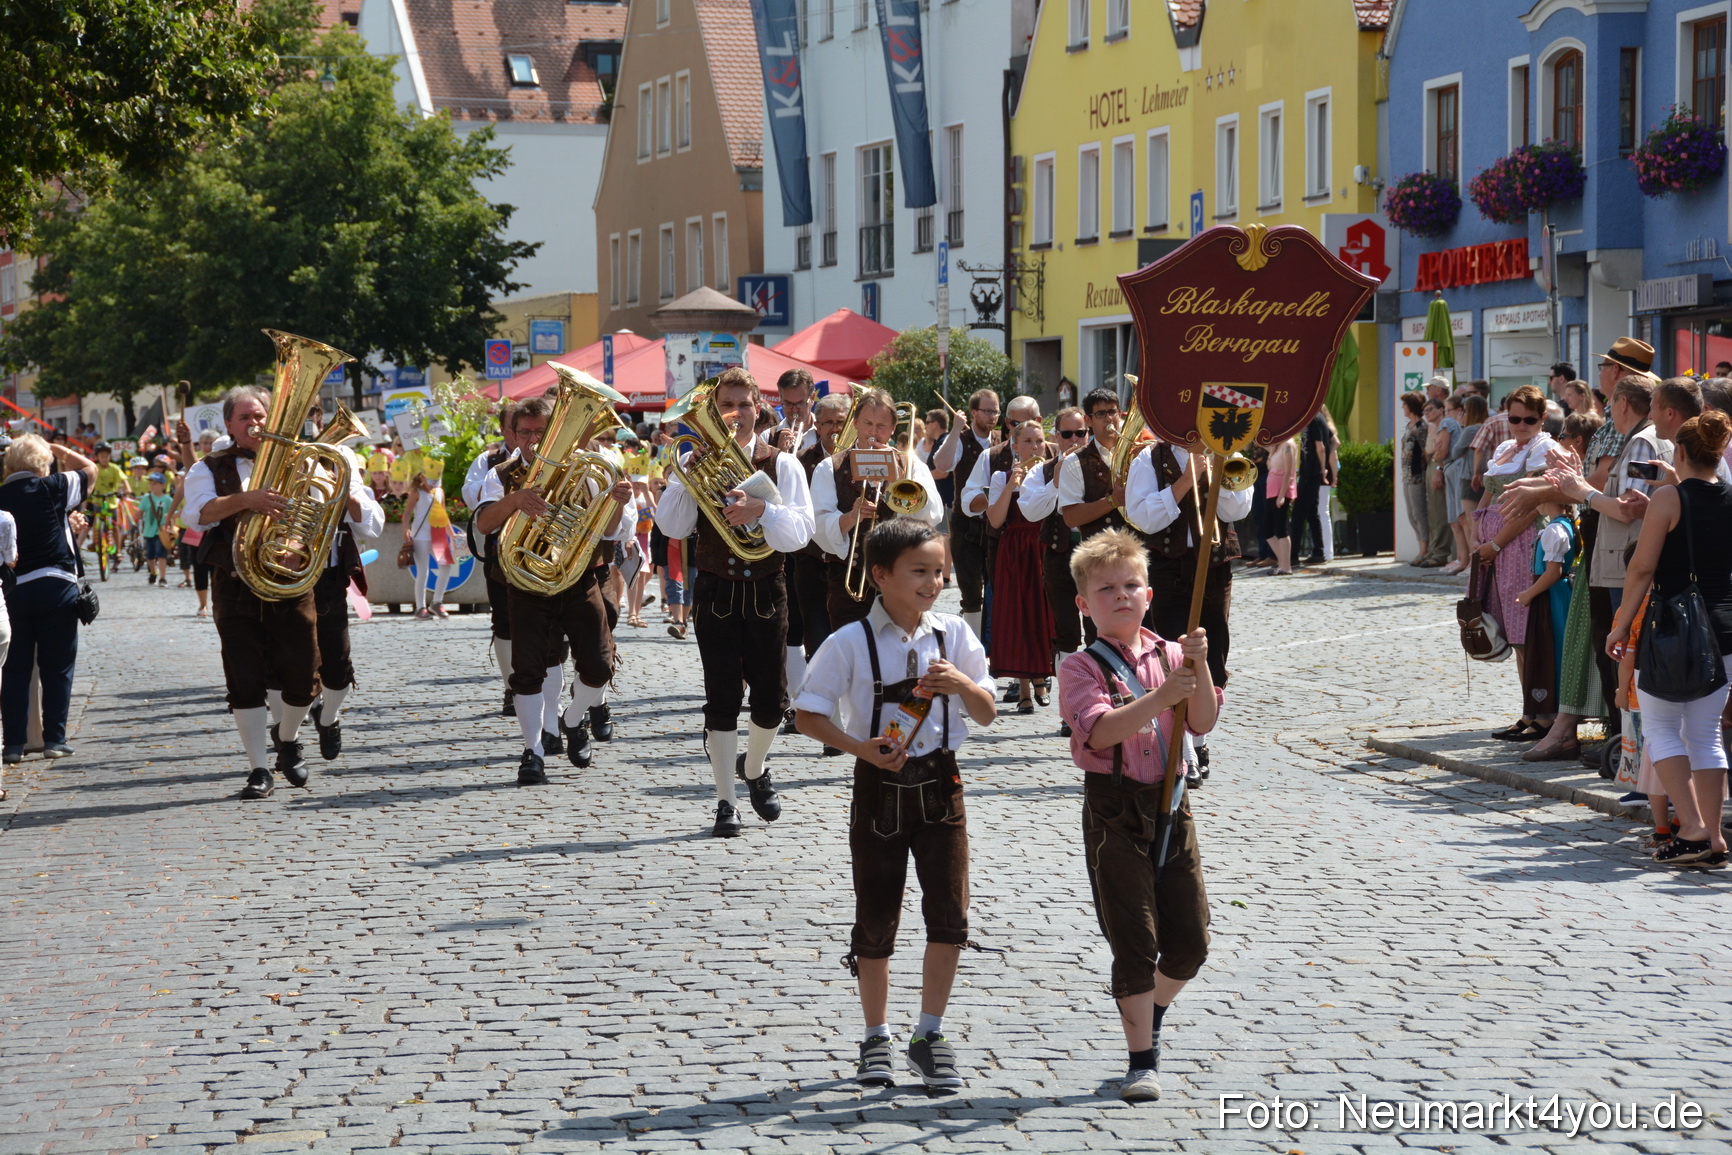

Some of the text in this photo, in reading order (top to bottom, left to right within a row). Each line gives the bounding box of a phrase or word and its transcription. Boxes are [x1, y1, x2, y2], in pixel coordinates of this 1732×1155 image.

[1090, 79, 1189, 130] HOTEL Lehmeier
[1413, 238, 1528, 292] APOTHEKE
[1085, 282, 1125, 309] Restaur
[1160, 286, 1331, 325] Blaskapelle
[1495, 309, 1549, 325] RATHAUS APOTHEK
[1179, 323, 1301, 363] Berngau
[489, 366, 510, 376] TAXI
[1178, 389, 1289, 403] 19 73
